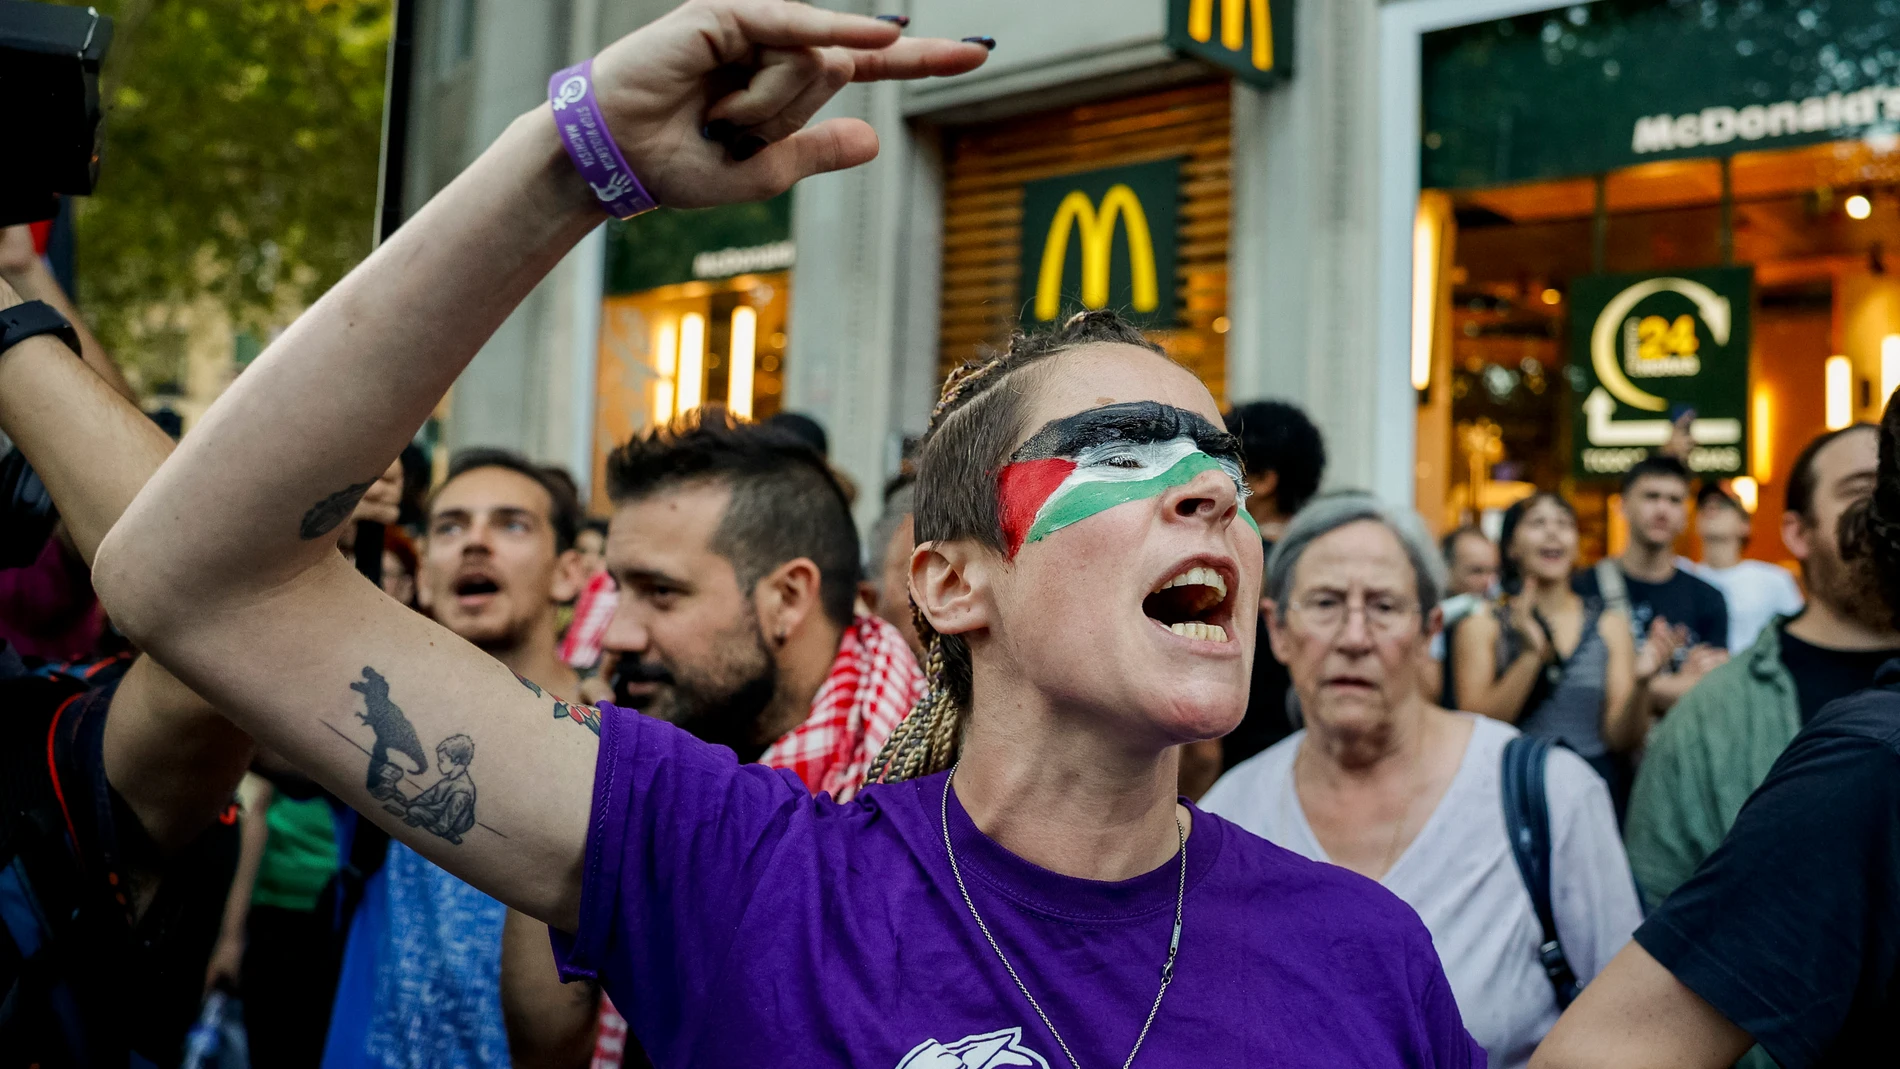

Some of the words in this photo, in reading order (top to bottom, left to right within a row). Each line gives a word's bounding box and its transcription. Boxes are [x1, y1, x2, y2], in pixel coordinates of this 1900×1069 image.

[565, 124, 595, 168] MACHISTA
[575, 106, 597, 130] STOP
[586, 129, 617, 171] VIOLENCIA
[1638, 315, 1699, 358] 24
